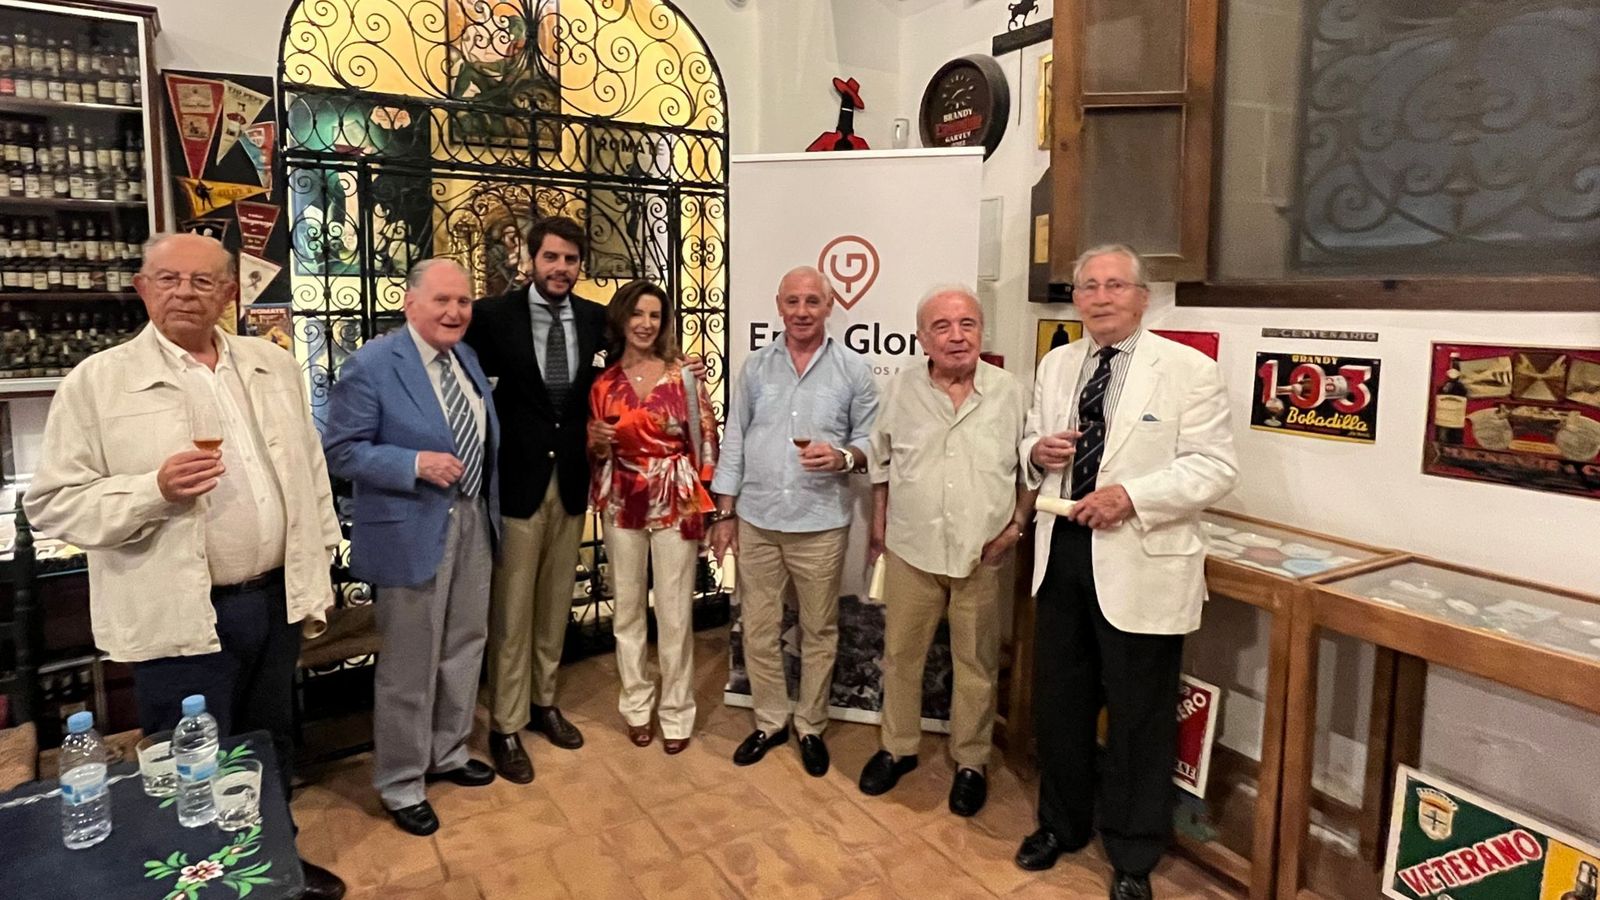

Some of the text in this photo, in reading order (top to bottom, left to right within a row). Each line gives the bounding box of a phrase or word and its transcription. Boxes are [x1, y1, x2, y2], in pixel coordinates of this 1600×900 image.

[943, 107, 973, 122] BRANDY
[945, 130, 971, 143] GARVEY
[844, 322, 930, 355] Glor
[1279, 329, 1377, 341] CENTENARIO
[1291, 354, 1338, 365] BRANDY
[1258, 359, 1372, 413] 103
[1286, 406, 1368, 431] Bobadilla
[1397, 828, 1543, 897] VETERANO
